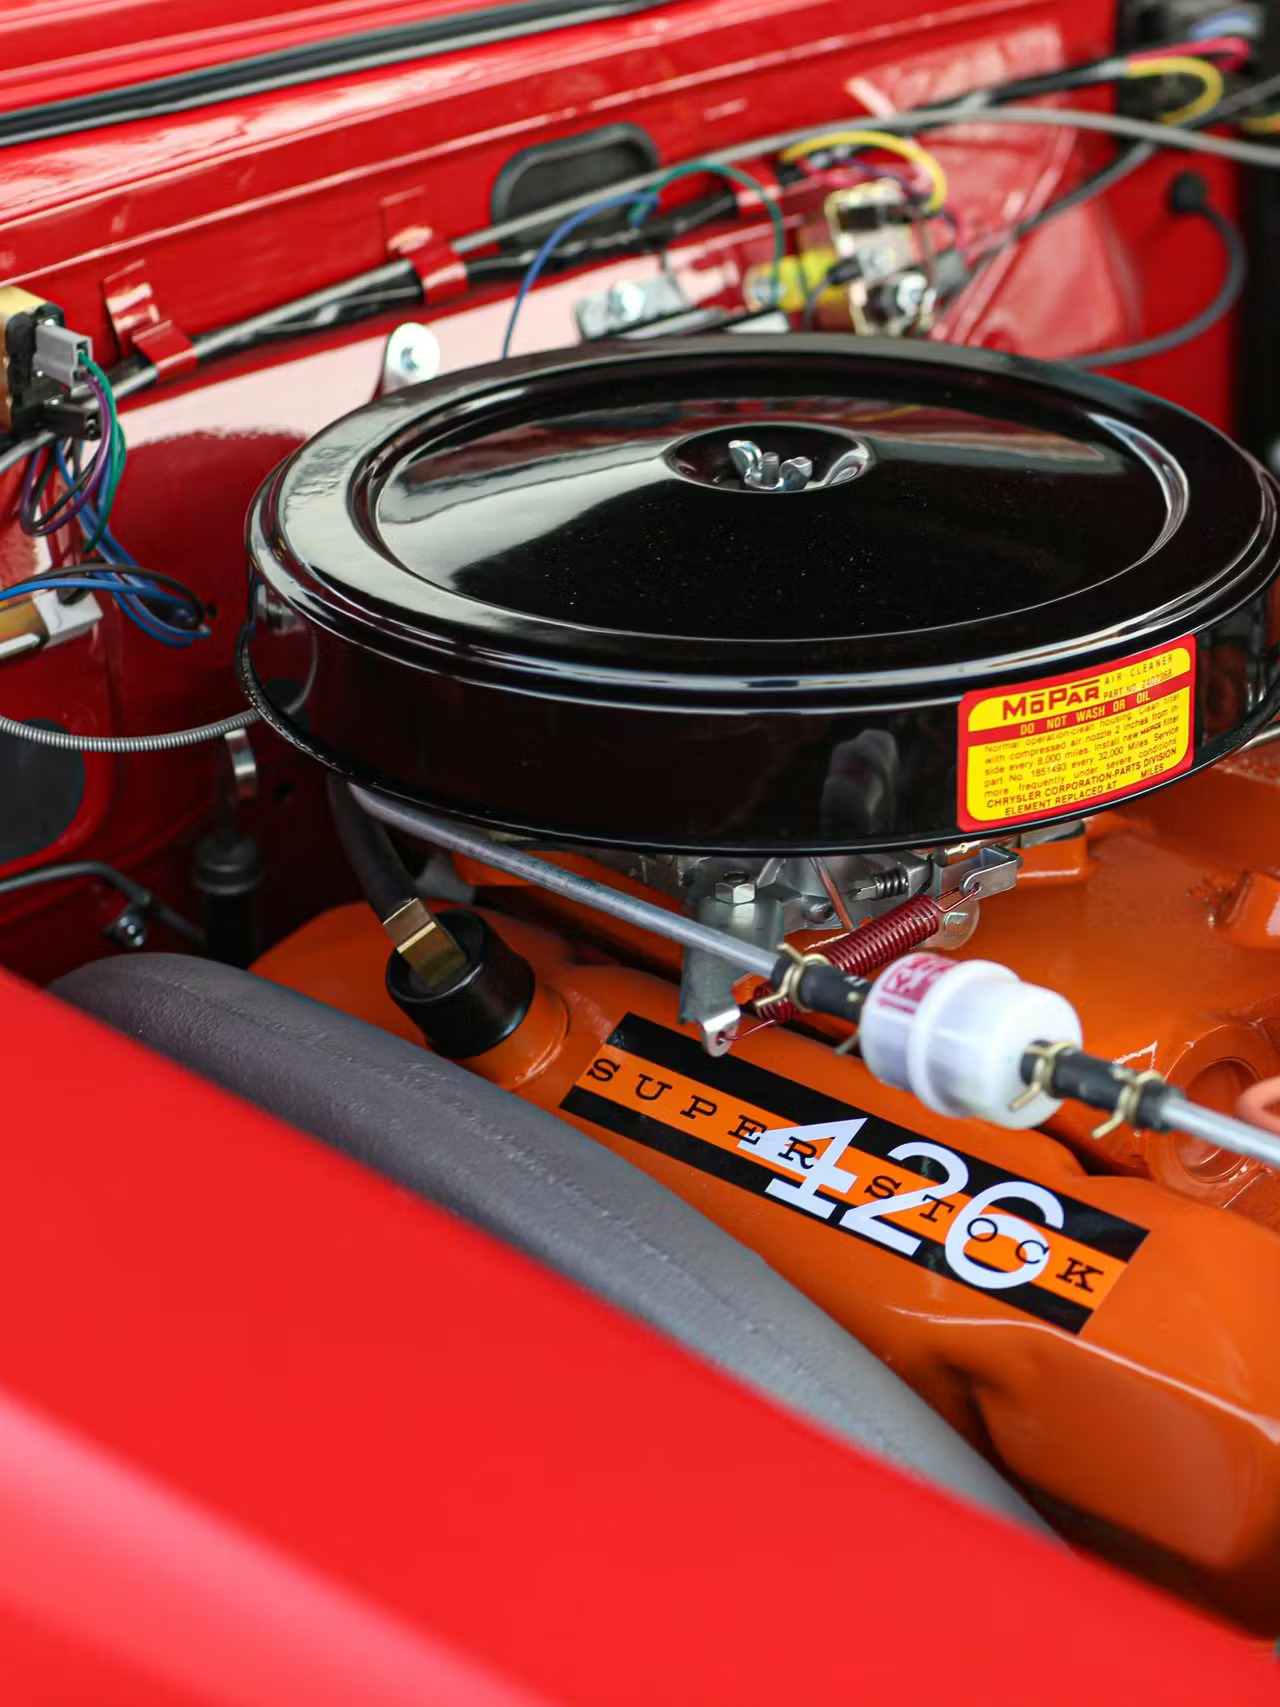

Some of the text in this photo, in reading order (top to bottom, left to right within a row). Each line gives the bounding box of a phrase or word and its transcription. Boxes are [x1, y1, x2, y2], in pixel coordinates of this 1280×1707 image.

[1104, 654, 1173, 685] AIR CLEANER
[1104, 687, 1122, 700] PART
[1020, 690, 1150, 736] DO NOT WASH OR OIL
[1009, 742, 1066, 761] compressed
[1009, 761, 1033, 772] every
[1018, 775, 1065, 792] frequently
[1105, 755, 1133, 771] severe
[1138, 737, 1178, 759] conditions
[1071, 757, 1094, 770] every
[986, 790, 1042, 809] CHRYSLER
[1143, 746, 1177, 768] DIVISION
[1140, 763, 1164, 779] MILES
[1004, 780, 1118, 816] ELEMENT REPLACED AT
[586, 1058, 1104, 1294] SUPER STOCK
[736, 1117, 1065, 1290] 426
